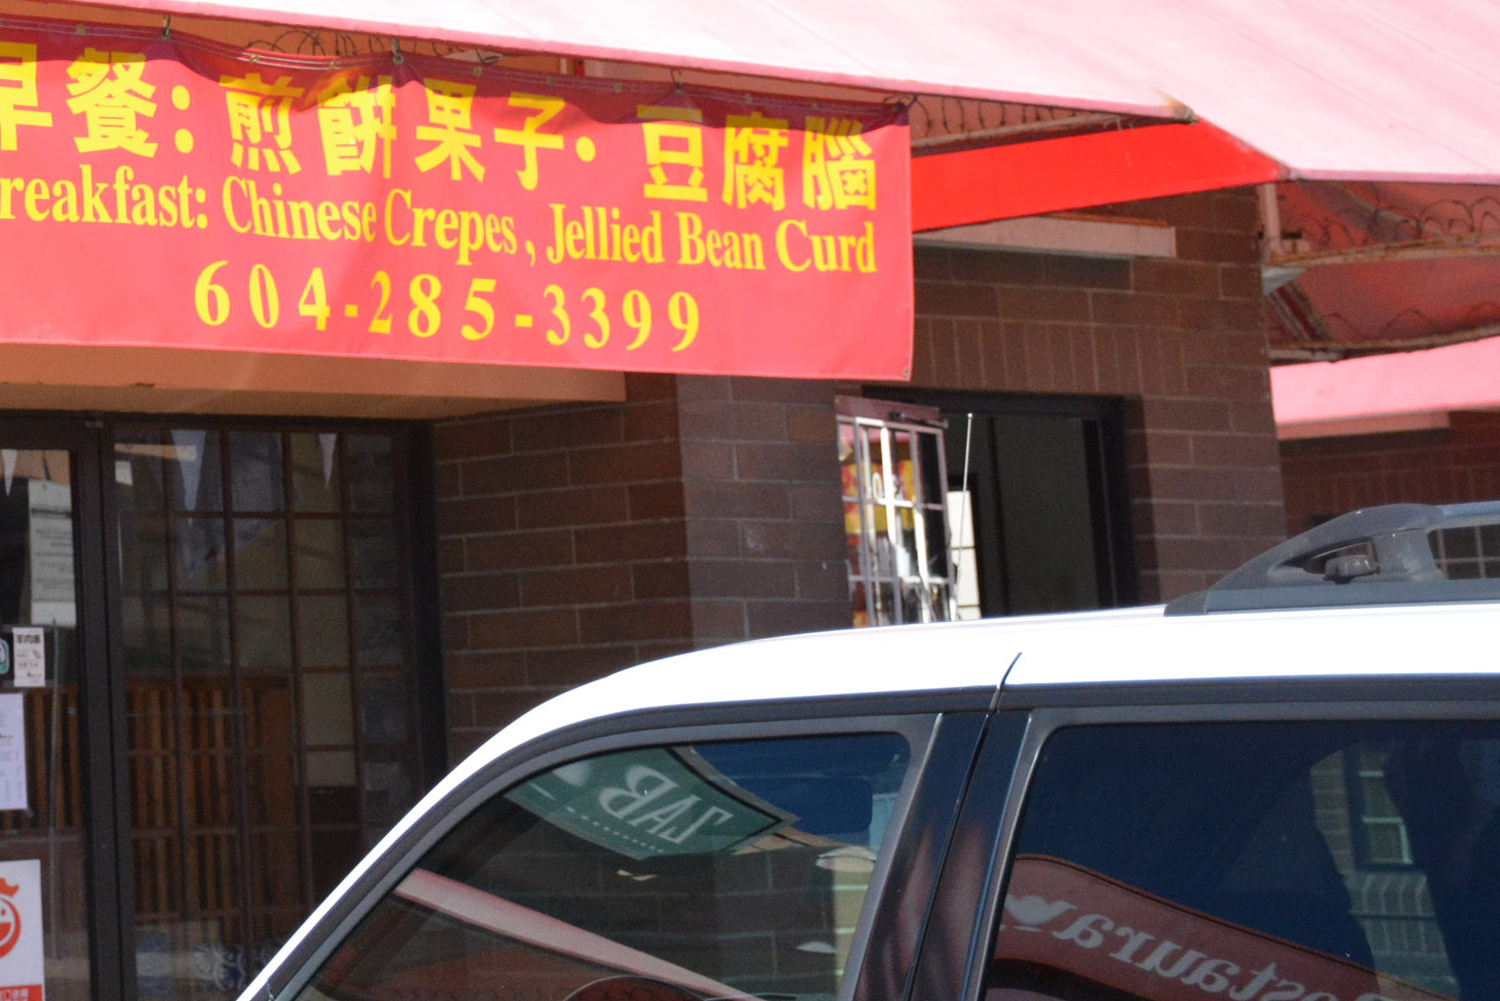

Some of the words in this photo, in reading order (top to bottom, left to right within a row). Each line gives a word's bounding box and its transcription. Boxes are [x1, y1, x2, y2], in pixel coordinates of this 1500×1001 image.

[222, 175, 377, 242] Chinese
[385, 188, 537, 266] Crepes,
[547, 203, 665, 264] Jellied
[675, 211, 765, 270] Bean
[775, 219, 877, 272] Curd
